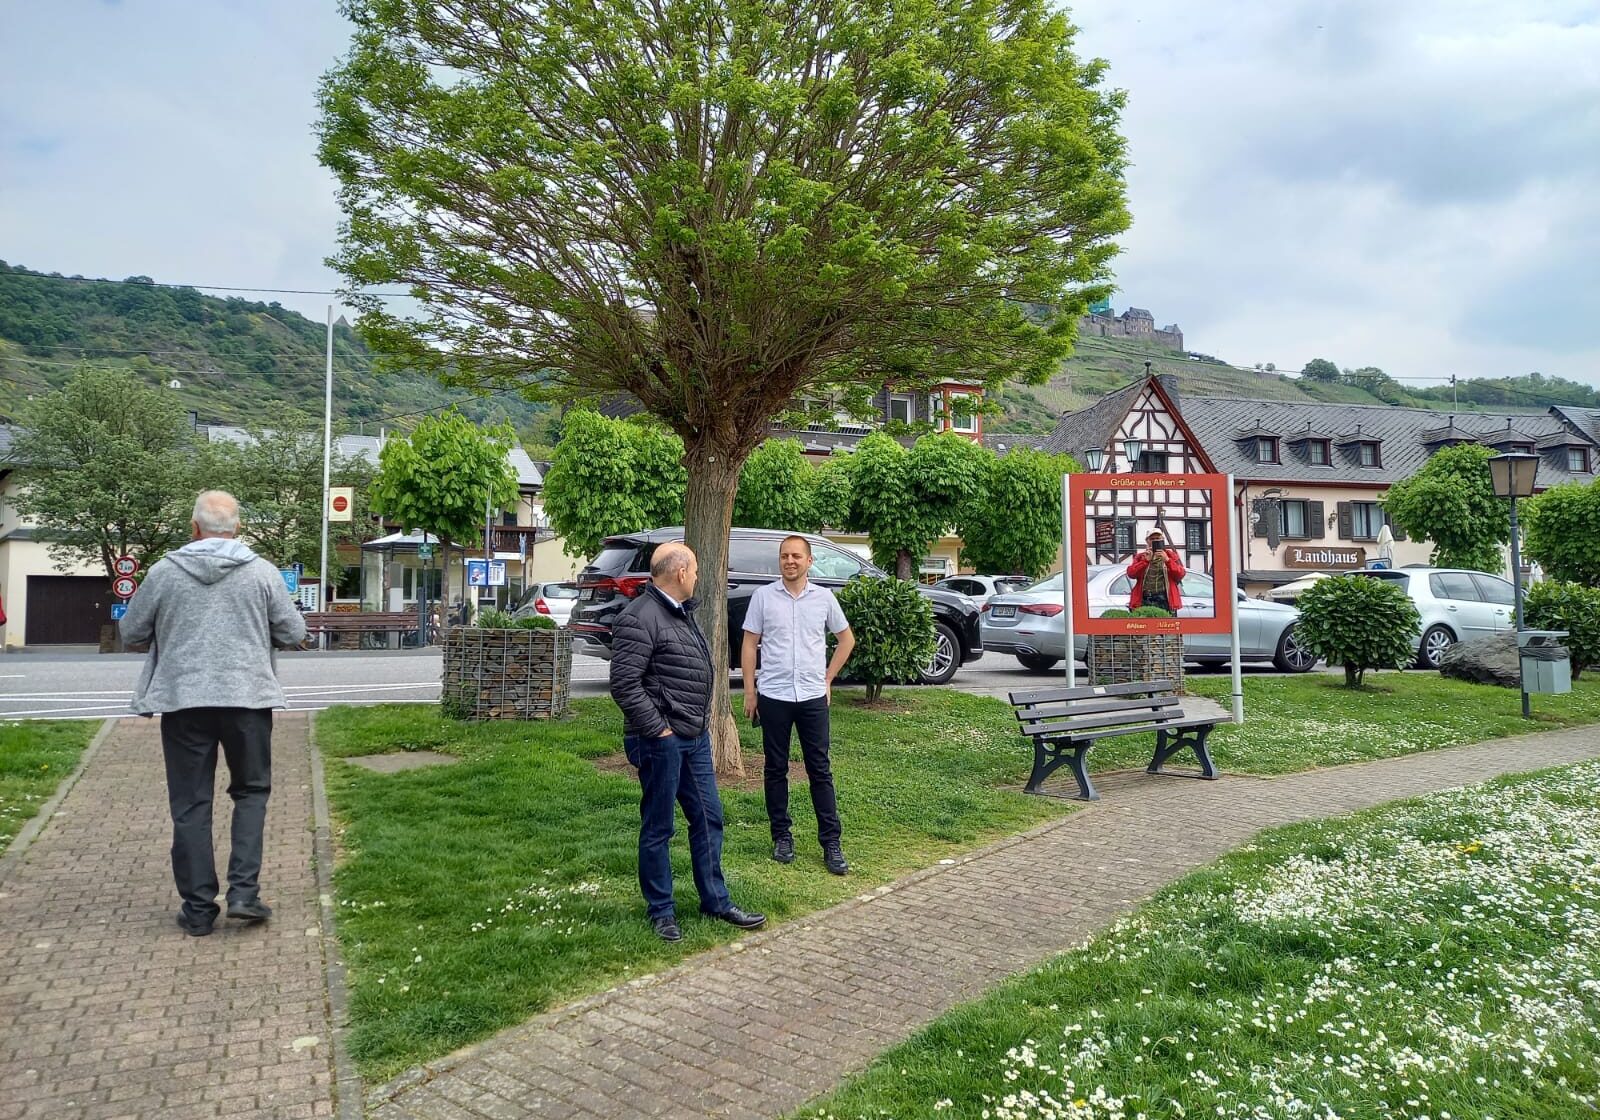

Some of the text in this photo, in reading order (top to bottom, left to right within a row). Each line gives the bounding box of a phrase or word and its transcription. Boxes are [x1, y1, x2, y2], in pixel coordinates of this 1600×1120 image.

[1110, 477, 1135, 486] Grüße
[1153, 478, 1175, 486] Alken
[1293, 549, 1358, 566] Landhaus
